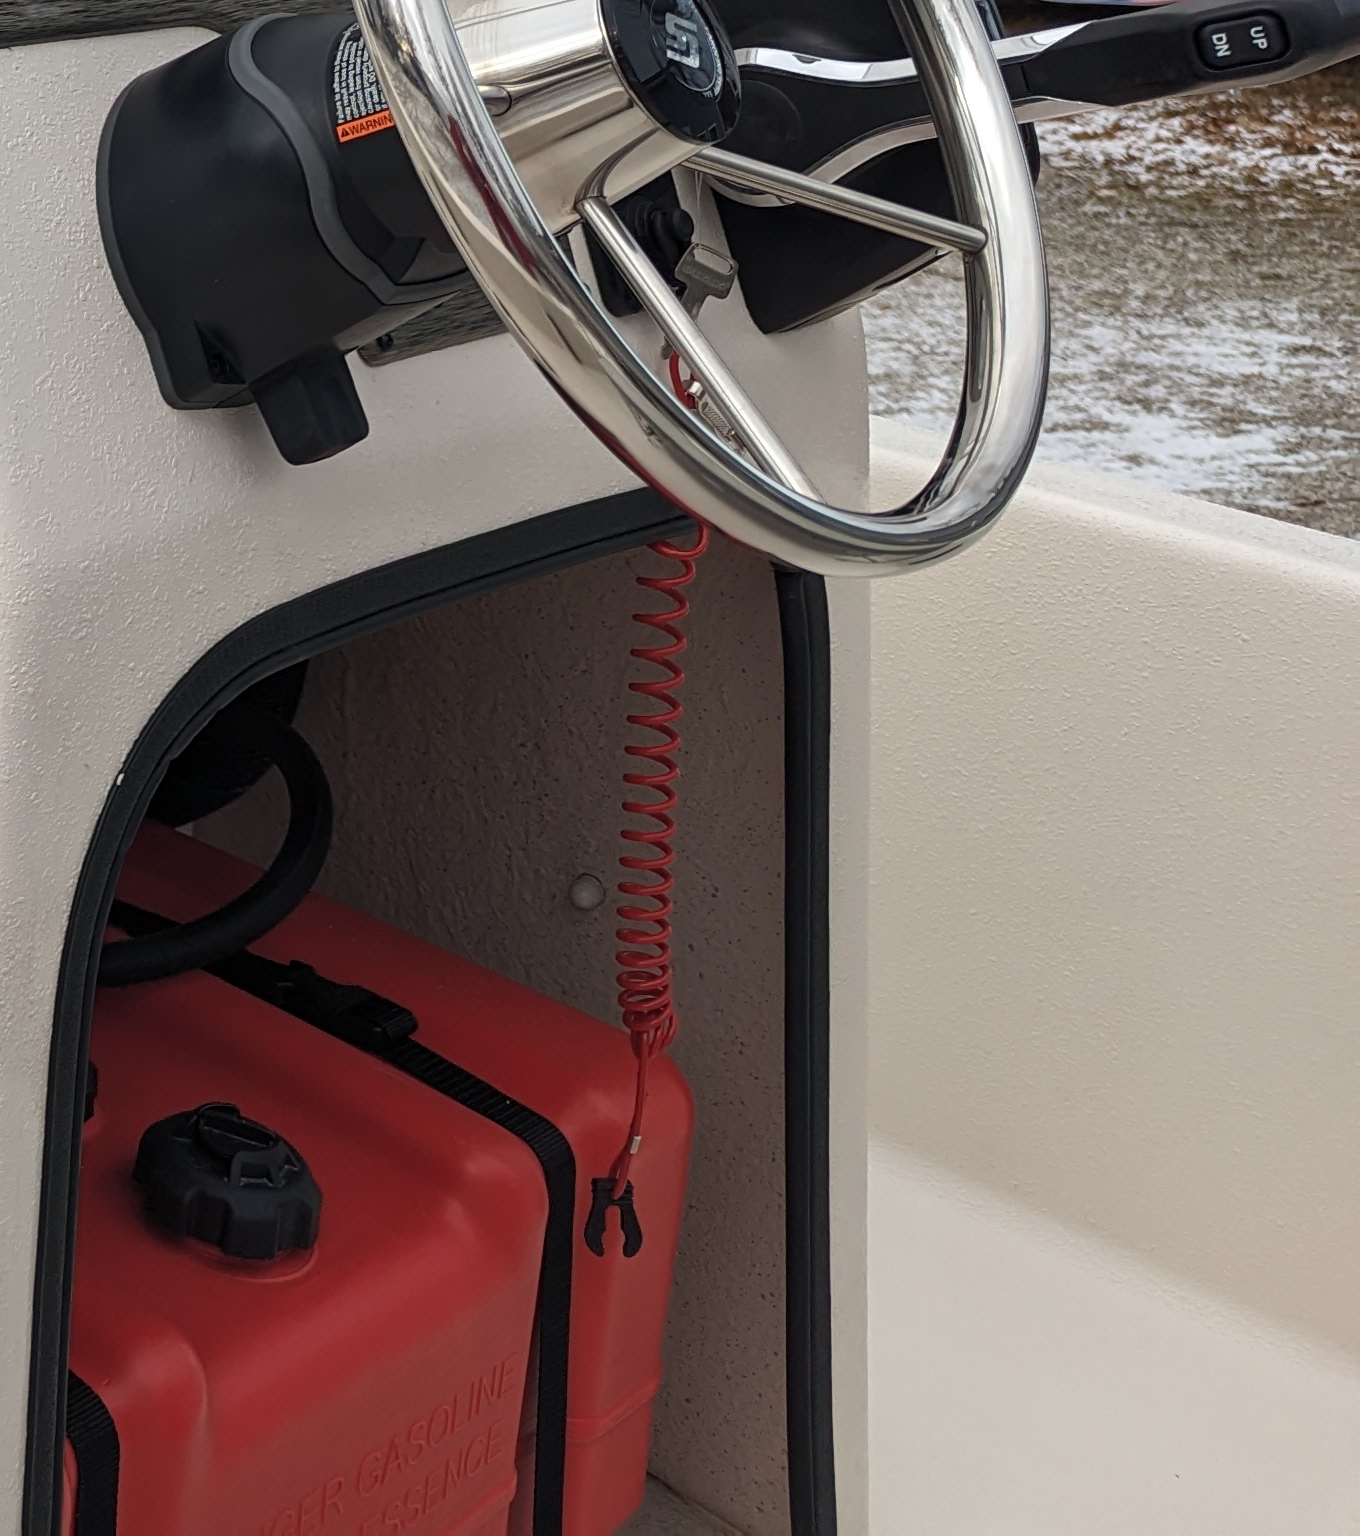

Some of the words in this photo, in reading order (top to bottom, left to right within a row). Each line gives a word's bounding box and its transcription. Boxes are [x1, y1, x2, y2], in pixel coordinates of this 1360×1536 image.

[1211, 32, 1232, 57] DN
[1250, 26, 1268, 50] UP
[348, 114, 392, 134] WARNIN
[356, 1351, 519, 1497] GASOLINE
